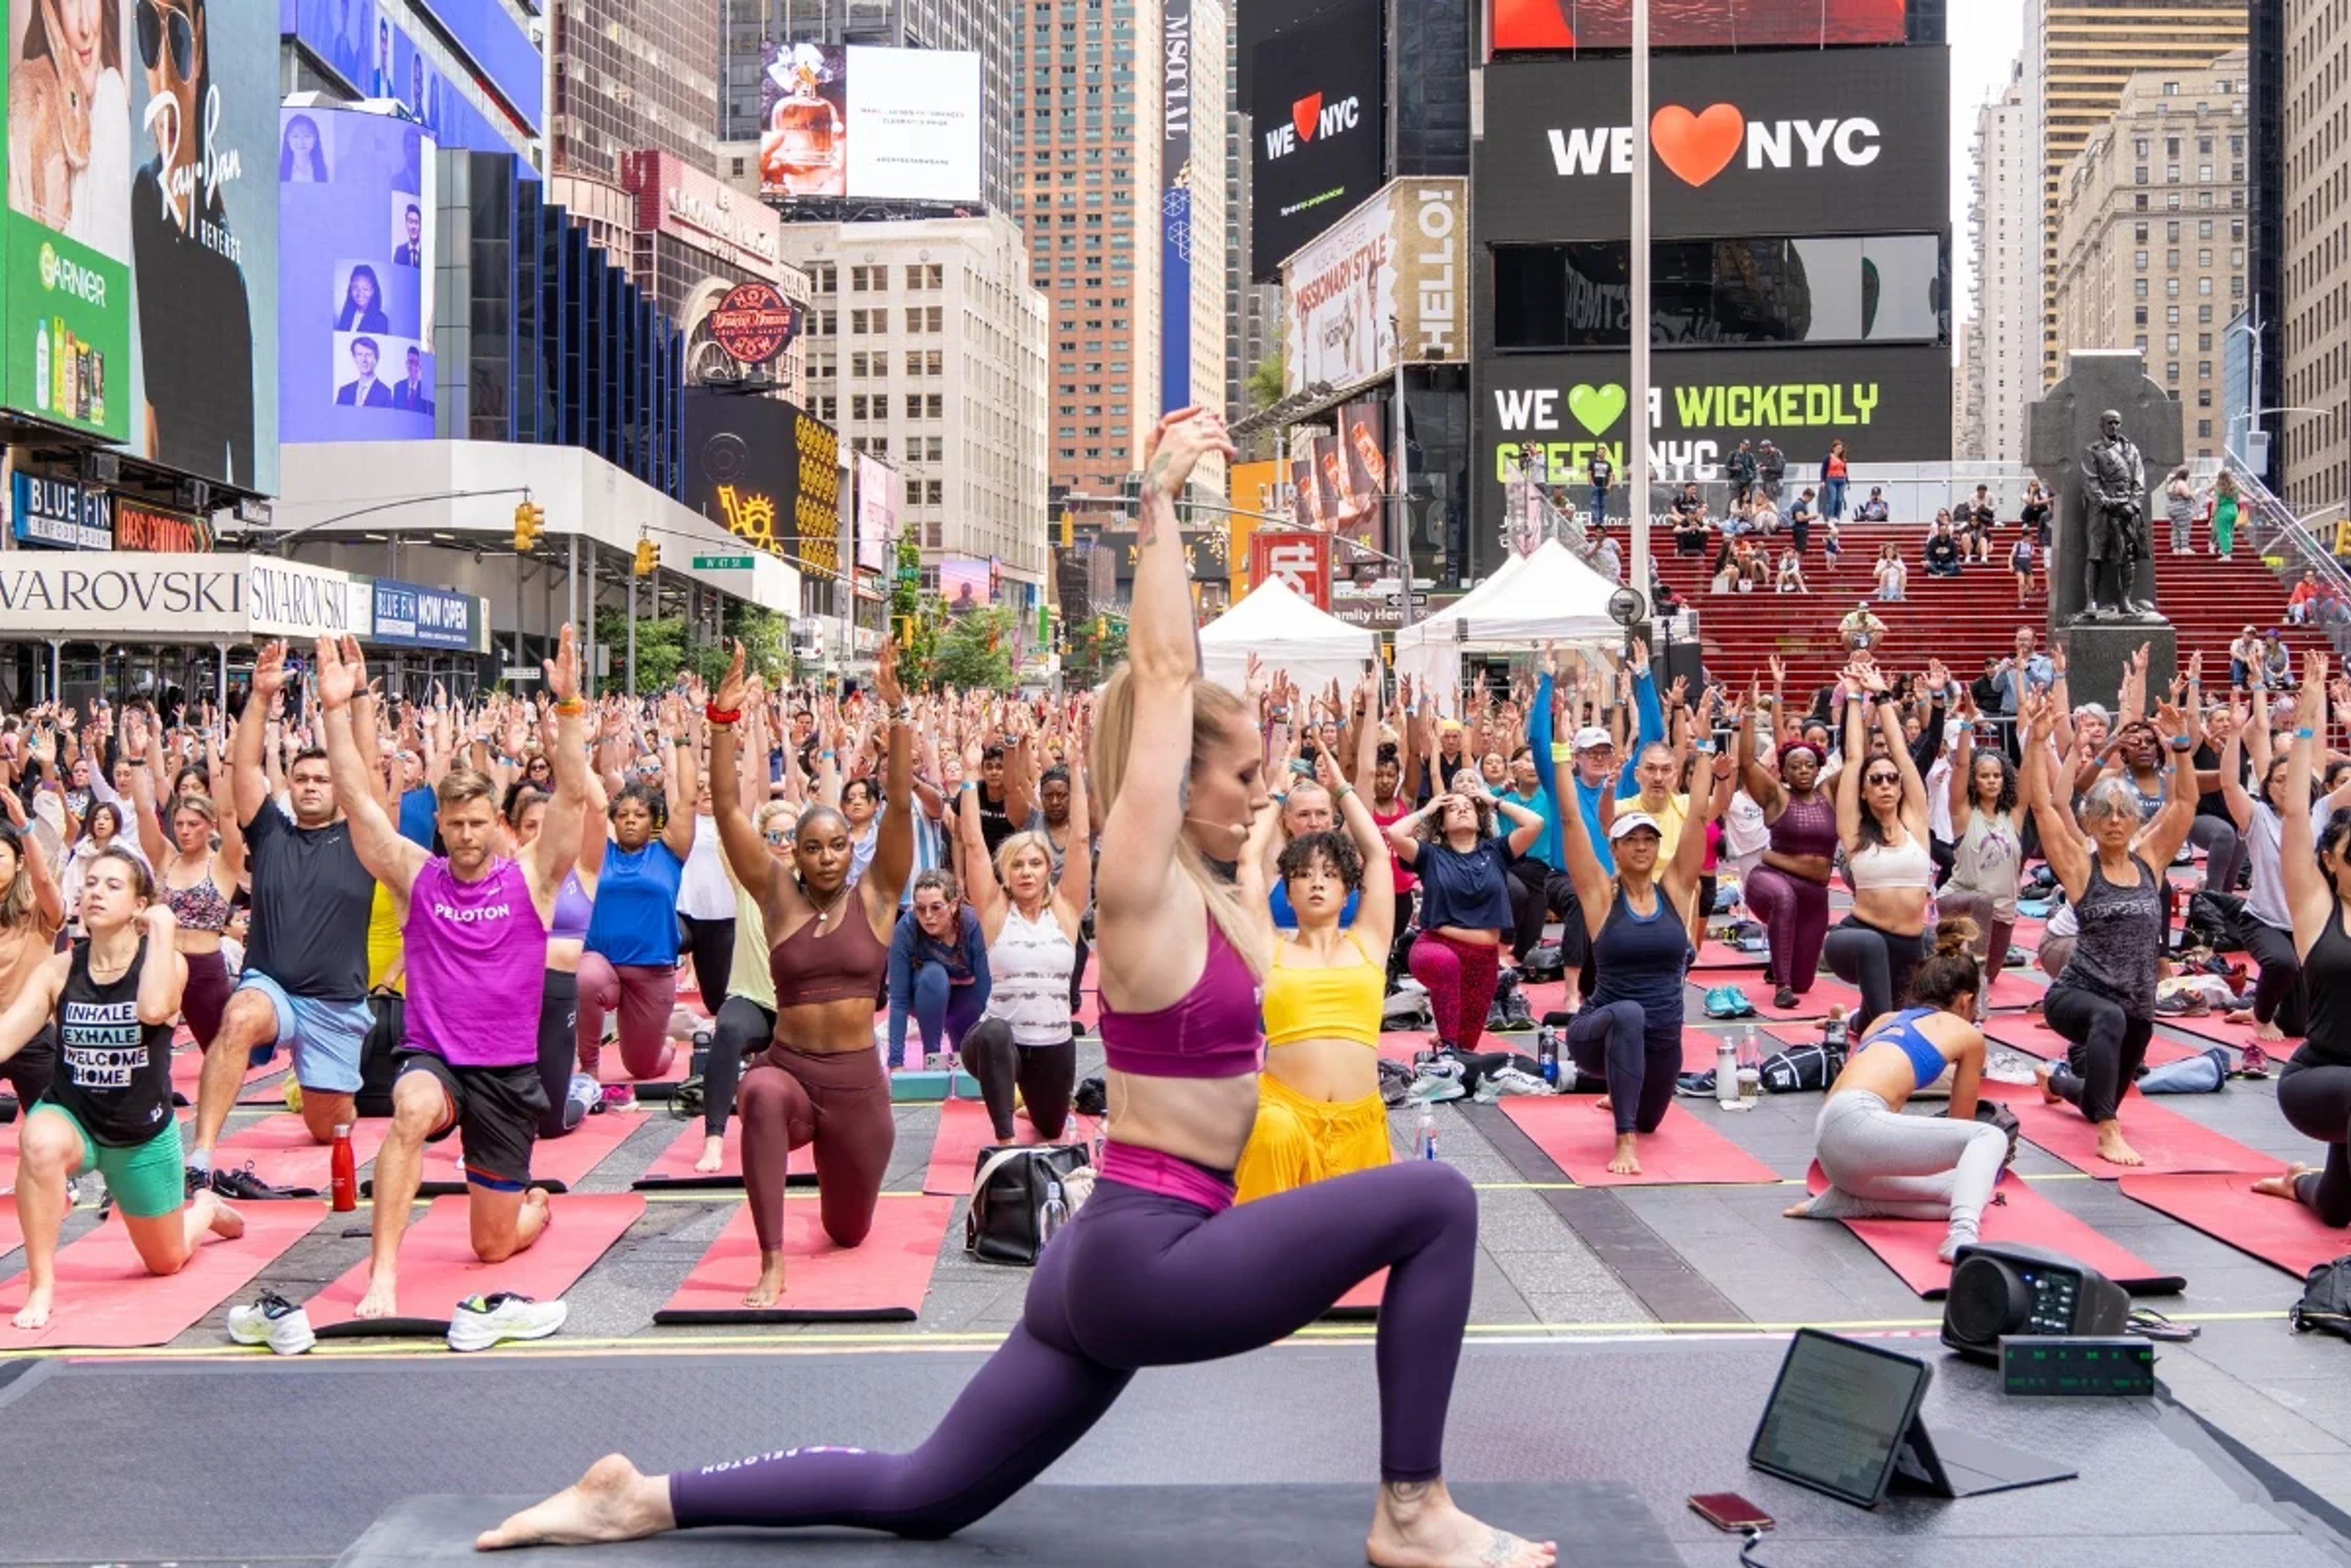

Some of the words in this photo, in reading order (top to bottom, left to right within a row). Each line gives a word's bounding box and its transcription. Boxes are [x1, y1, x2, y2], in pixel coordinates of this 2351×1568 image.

[1266, 122, 1295, 160] WE
[1320, 96, 1359, 140] NYC
[1548, 127, 1633, 176] WE
[1747, 117, 1881, 169] NYC
[1418, 190, 1454, 354] HELLO!
[1494, 389, 1559, 430] WE
[1674, 383, 1878, 427] WICKEDLY
[1648, 440, 1718, 482] NYC
[31, 478, 77, 520] BLUE
[83, 492, 111, 528] FIN
[251, 566, 348, 630] SWAROVSKI
[377, 591, 399, 618] BLUE
[418, 593, 442, 627] NOW
[443, 597, 467, 631] OPEN
[435, 903, 509, 921] PELOTON
[67, 1005, 138, 1021] INHALE.
[64, 1029, 140, 1044] EXHALE.
[67, 1048, 146, 1066] WELCOME
[75, 1068, 130, 1085] HOME.
[702, 1448, 798, 1475] PELOTON
